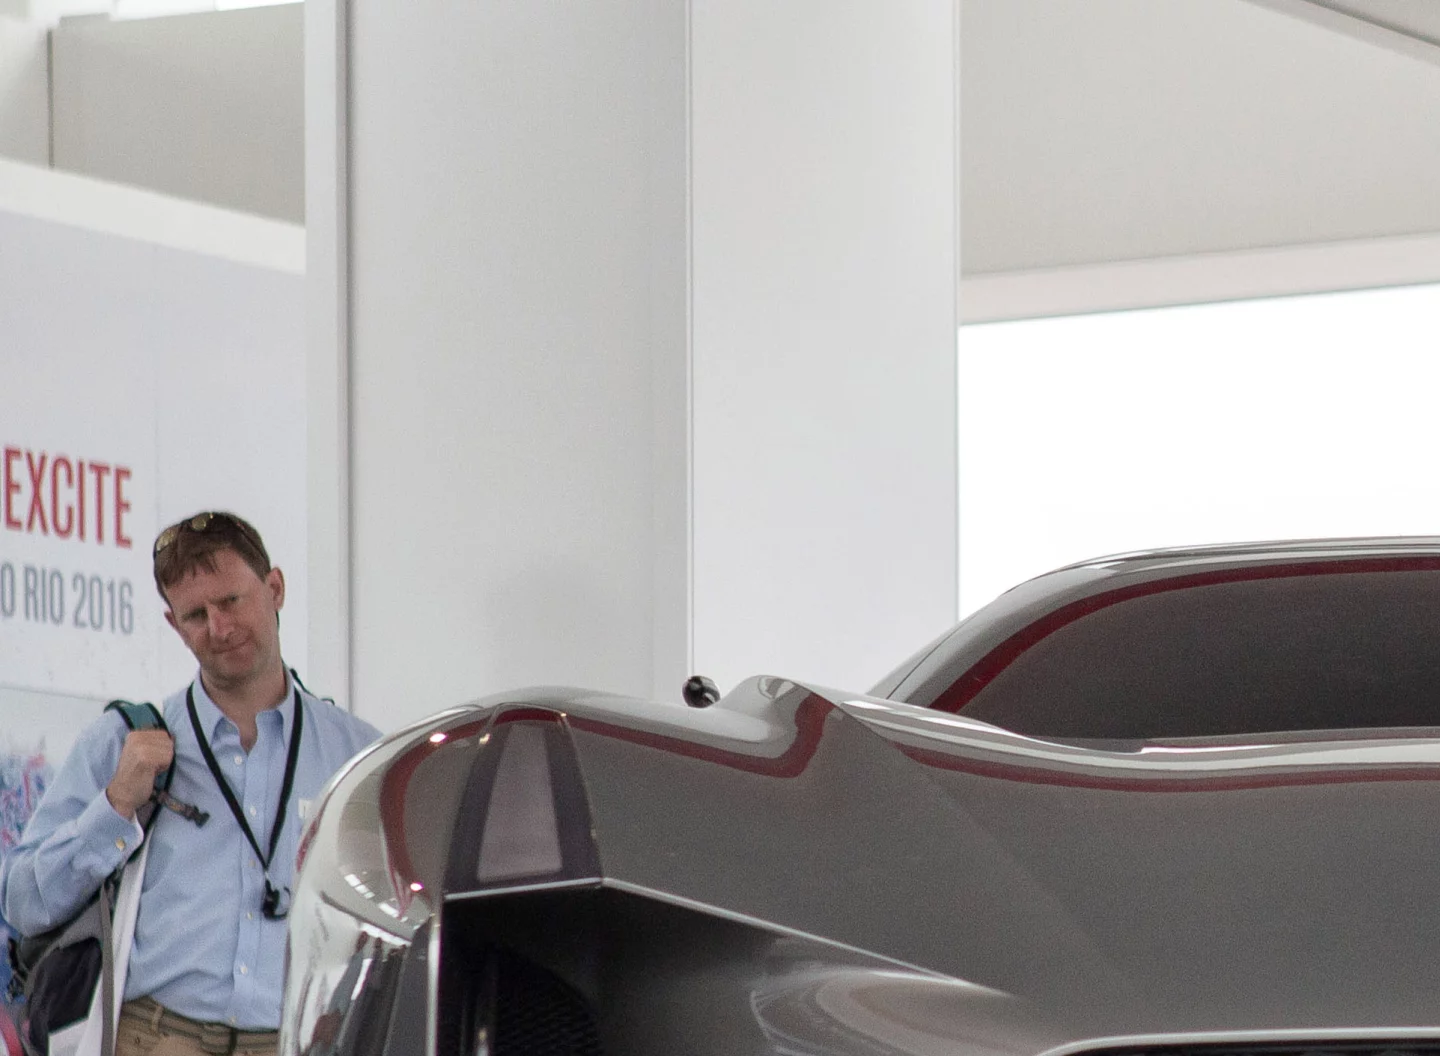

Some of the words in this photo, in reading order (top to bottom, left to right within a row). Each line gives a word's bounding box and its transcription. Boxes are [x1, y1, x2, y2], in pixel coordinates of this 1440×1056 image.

[4, 447, 132, 549] EXCITE
[24, 564, 64, 626] RIO
[72, 571, 134, 635] 2016
